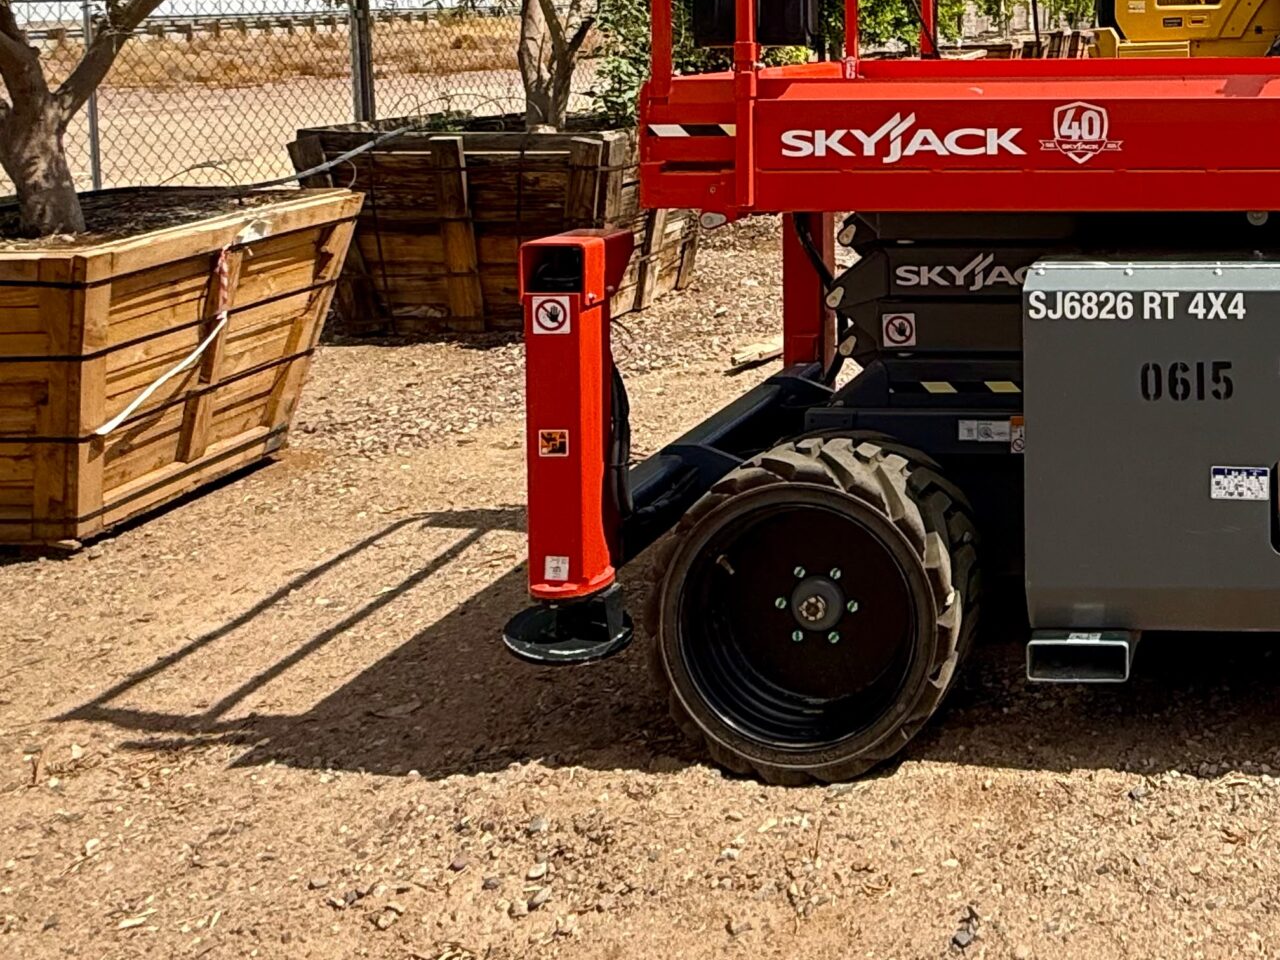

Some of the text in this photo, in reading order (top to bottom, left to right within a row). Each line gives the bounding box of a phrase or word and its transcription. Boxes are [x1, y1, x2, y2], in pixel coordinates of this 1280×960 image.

[781, 112, 1027, 163] SKYJACK
[1060, 107, 1101, 140] 40
[1028, 291, 1246, 320] SJ6826 RT 4X4
[1140, 361, 1234, 401] 0615
